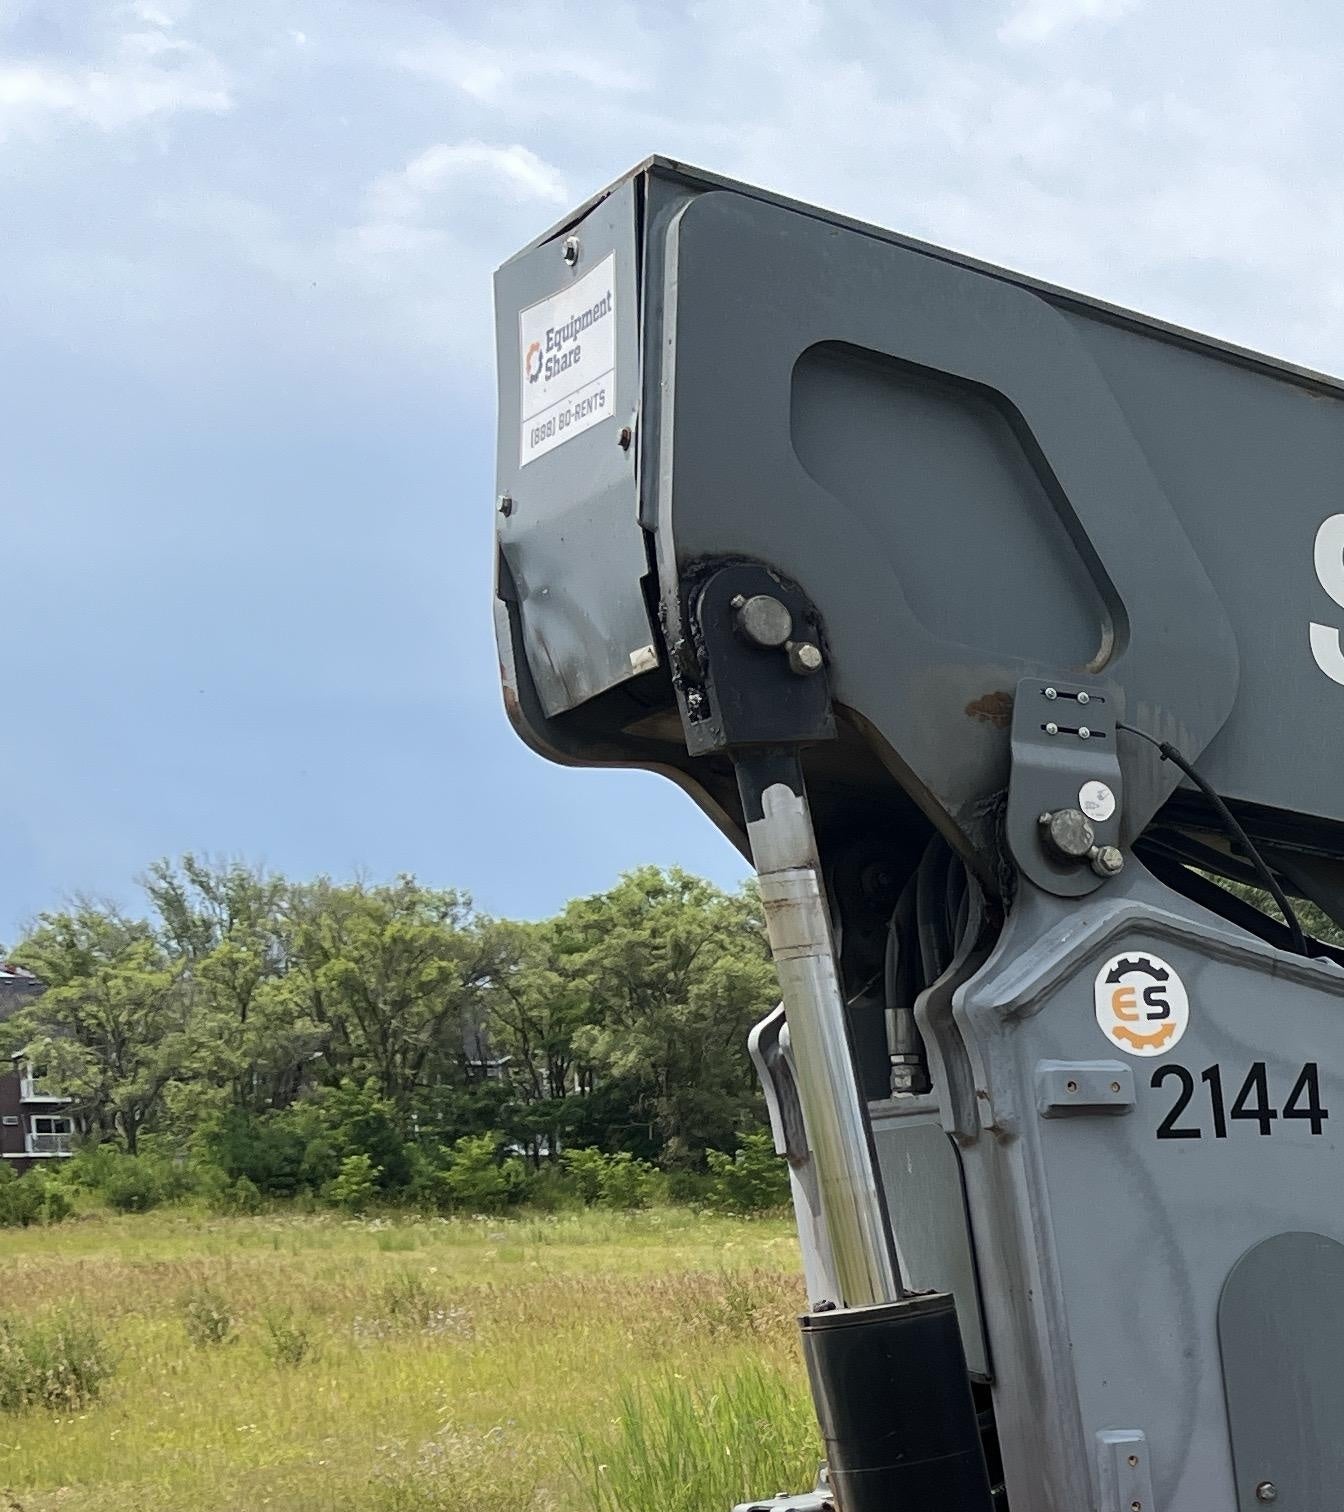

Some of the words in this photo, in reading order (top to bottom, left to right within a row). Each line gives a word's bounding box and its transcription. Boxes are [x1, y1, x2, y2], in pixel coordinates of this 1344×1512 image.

[545, 290, 612, 351] Equipment
[544, 345, 581, 381] Share
[530, 416, 556, 449] (888)
[558, 390, 606, 431] 80-RENTS
[1111, 985, 1171, 1021] ES
[1150, 1062, 1329, 1140] 2144
